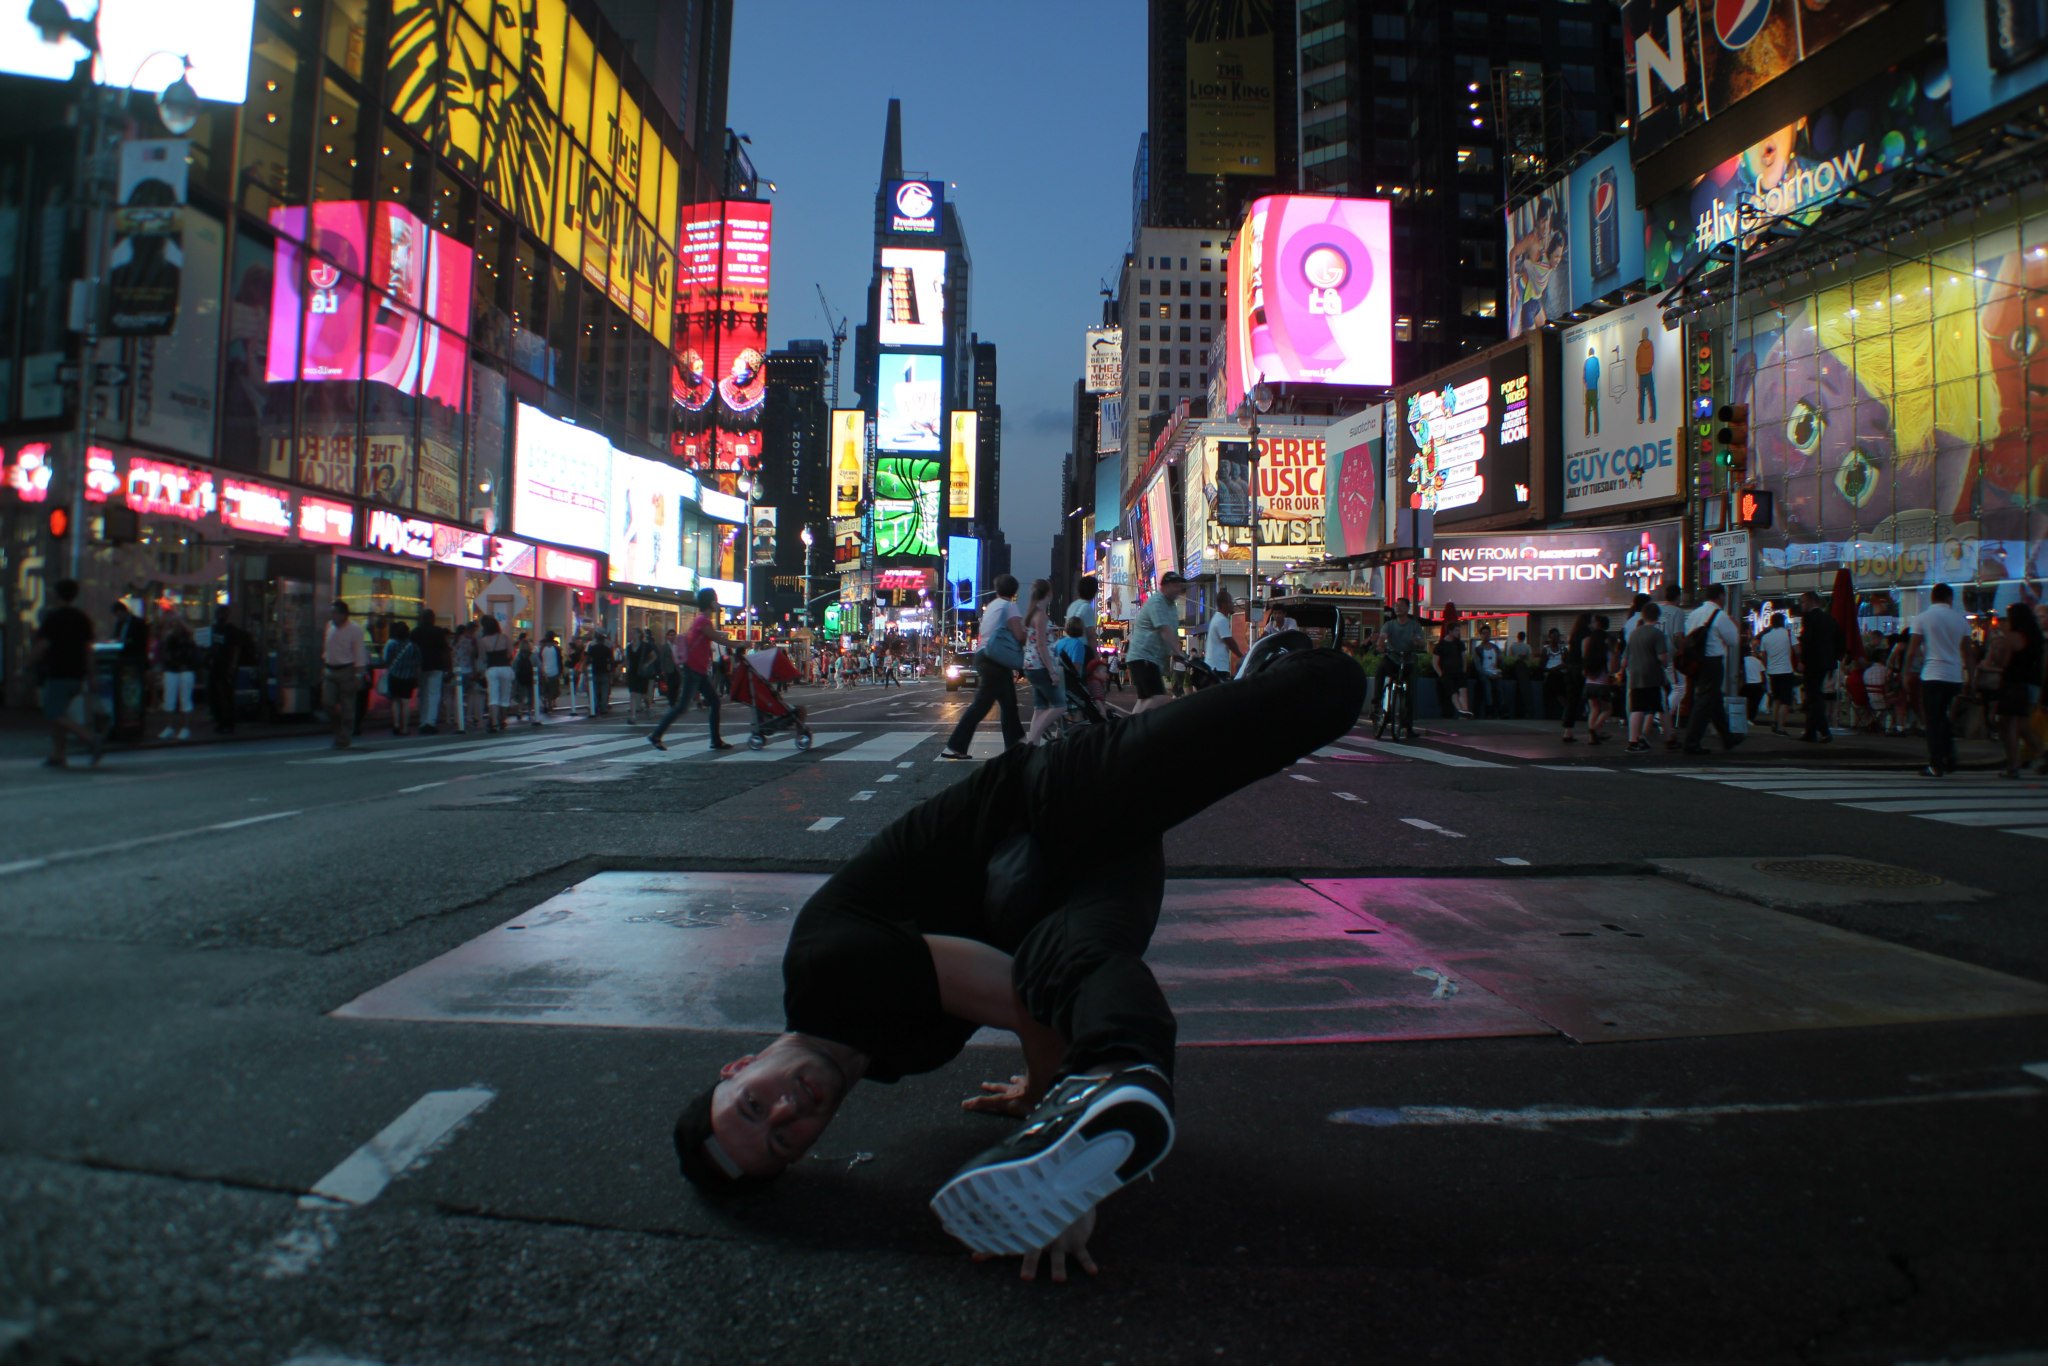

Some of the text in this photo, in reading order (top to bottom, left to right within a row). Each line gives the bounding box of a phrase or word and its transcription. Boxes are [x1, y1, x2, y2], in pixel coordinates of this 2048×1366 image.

[1217, 64, 1244, 77] THE
[1232, 80, 1271, 101] KING
[607, 110, 638, 184] THE
[563, 123, 668, 300] LION KING
[1350, 421, 1372, 437] swatch
[1501, 424, 1528, 445] NOON
[791, 431, 800, 494] NOVOTEL
[1567, 438, 1673, 485] GUY CODE
[1566, 486, 1580, 499] JULY
[1582, 484, 1588, 496] 17
[1590, 479, 1617, 494] TUESDAY
[1270, 497, 1319, 510] FOR OUR
[836, 521, 859, 532] INGLOT
[1714, 534, 1746, 547] WATCH YOUR
[1441, 549, 1475, 561] NEW
[1477, 548, 1517, 560] FROM
[1723, 547, 1737, 557] STEP
[1713, 557, 1748, 569] ROAD PLATES
[1721, 570, 1739, 581] AHEAD
[880, 576, 925, 589] RACE
